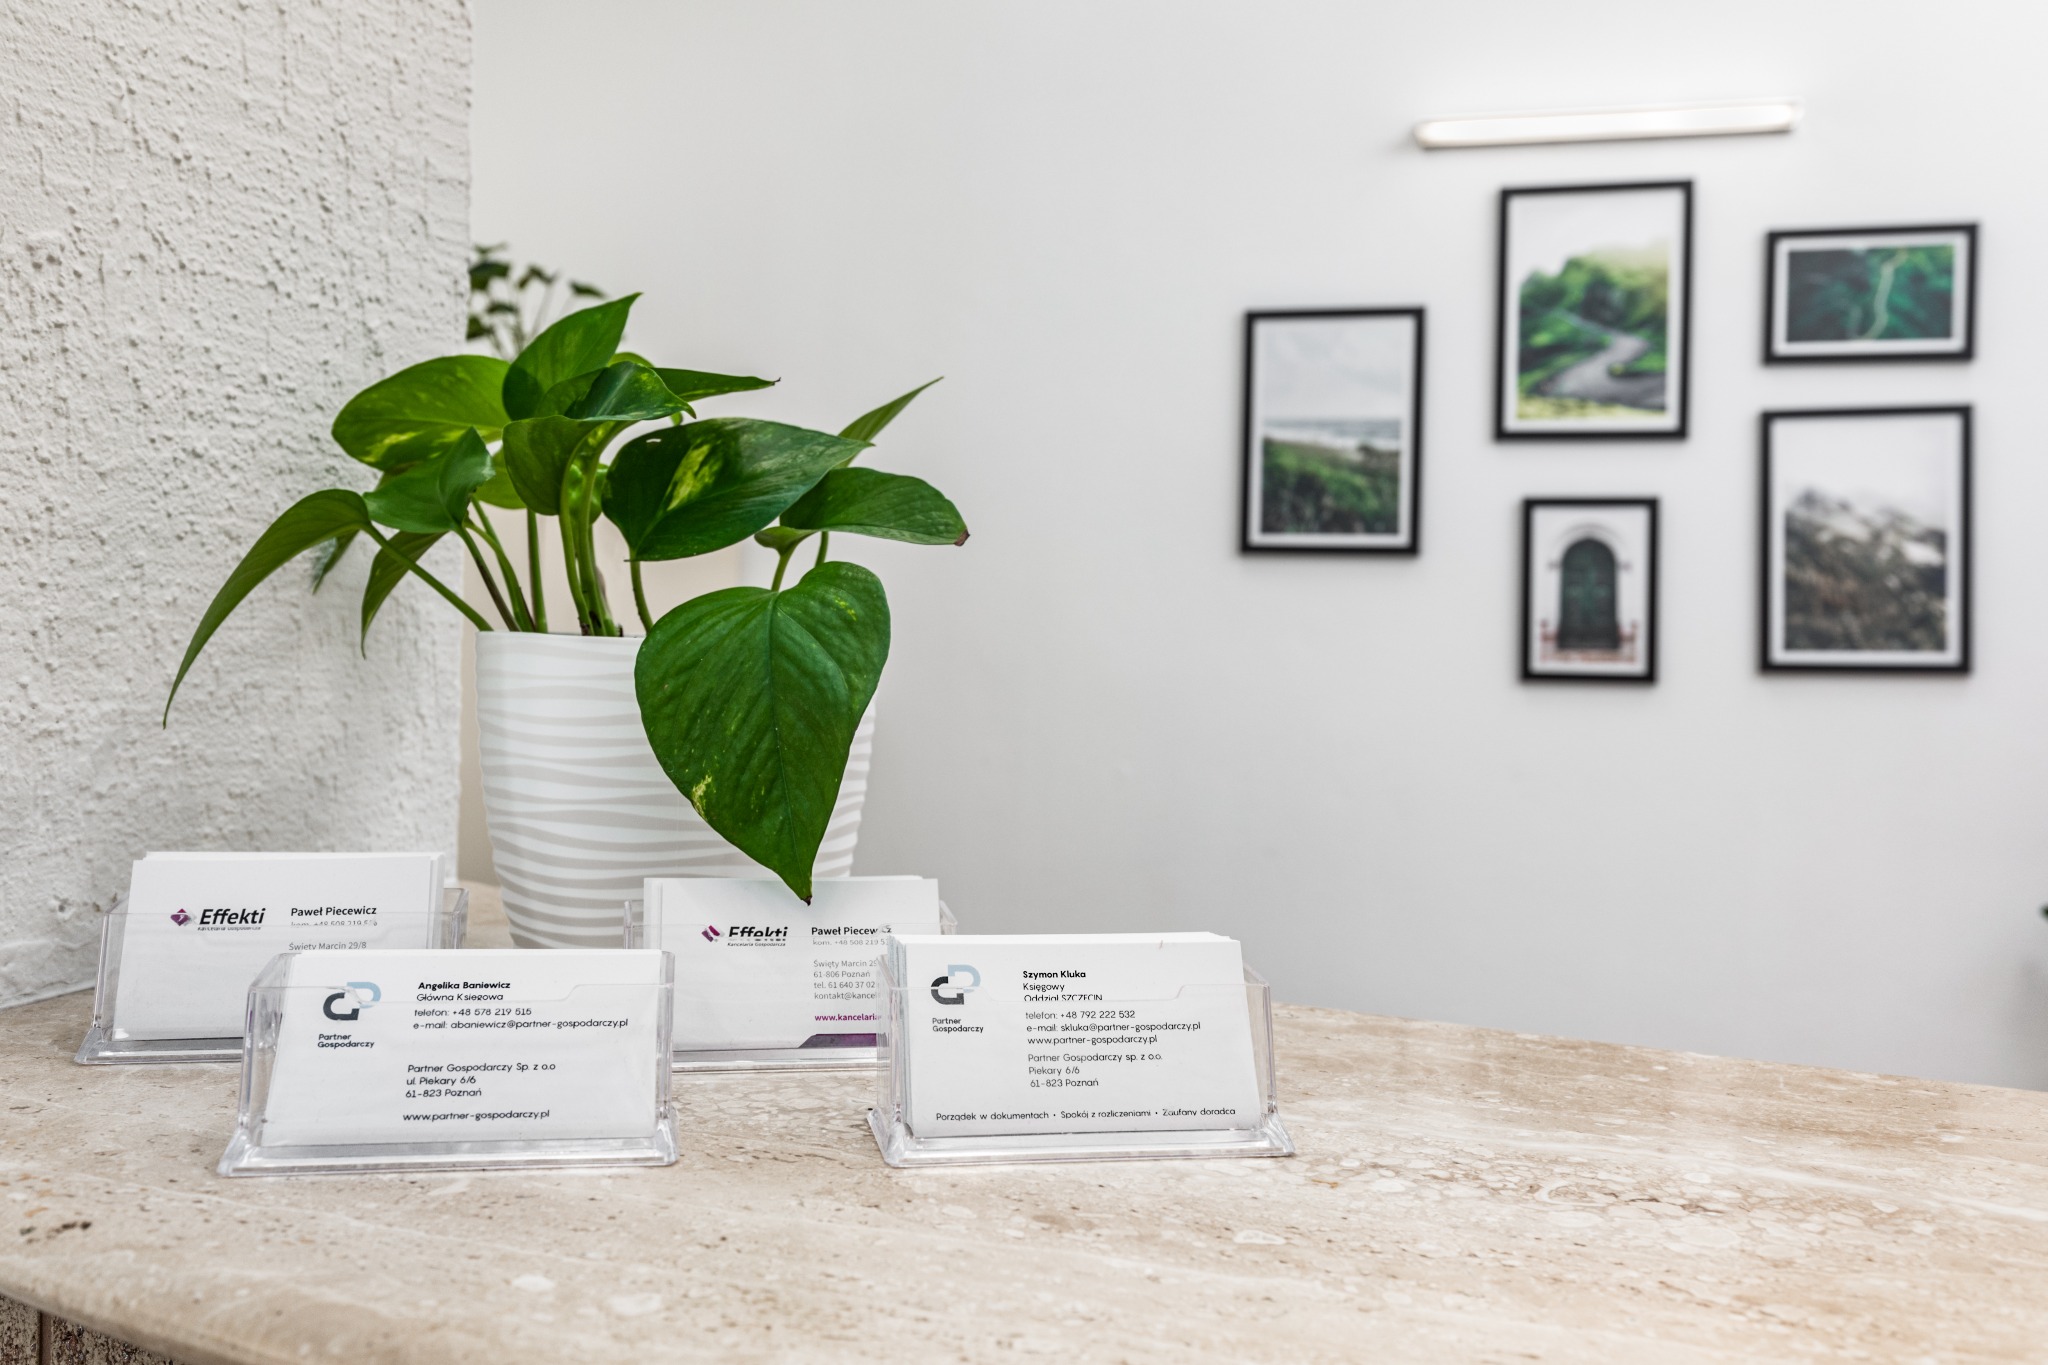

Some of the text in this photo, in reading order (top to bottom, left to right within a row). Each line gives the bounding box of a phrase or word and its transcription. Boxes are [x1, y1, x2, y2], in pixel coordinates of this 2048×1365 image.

[199, 908, 267, 925] Effekti
[290, 905, 377, 917] Paweł Piecewicz
[811, 926, 842, 936] Paweł
[318, 941, 347, 950] Marcin
[346, 939, 369, 950] 29/8
[813, 959, 840, 970] Święty
[841, 970, 871, 978] Poznań
[1022, 969, 1087, 981] Szymon Kluka
[417, 981, 511, 992] Angelika Baniewicz
[813, 981, 827, 989] tel.
[839, 981, 854, 989] 640
[854, 981, 865, 989] 37
[865, 981, 877, 989] 02
[1022, 982, 1065, 993] Księgowy
[416, 993, 455, 1002] Główna
[414, 1007, 533, 1017] telefon: +48 578 219 515
[1025, 1009, 1136, 1020] telefon: +48 792 222 532
[412, 1018, 629, 1031] e-mail: abaniewicz@partner-gospodarczy.pl
[932, 1017, 962, 1026] Partner
[1026, 1021, 1201, 1033] e-mail: skluka@partner-gospodarczy.pl
[932, 1025, 984, 1034] Gospodarczy
[318, 1033, 352, 1042] Partner
[1027, 1032, 1158, 1046] www.partner-gospodarczy.pl
[317, 1039, 375, 1050] Gospodarczy
[1027, 1053, 1061, 1062] Partner
[1062, 1052, 1123, 1063] Gospodarczy
[1125, 1054, 1138, 1062] sp.
[407, 1064, 444, 1073] Partner
[446, 1063, 513, 1074] Gospodarczy
[532, 1063, 539, 1071] z
[1028, 1065, 1081, 1077] Piekary 6/6
[418, 1076, 457, 1086] Piekary
[459, 1076, 477, 1085] 6/6
[1029, 1077, 1099, 1088] 61-823 Poznań
[405, 1088, 483, 1099] 61-823 Poznań
[402, 1109, 550, 1122] www.partner-gospodarczy.pl
[990, 1110, 1050, 1120] dokumentach
[1060, 1109, 1089, 1119] Spokój
[1199, 1107, 1236, 1116] doradca
